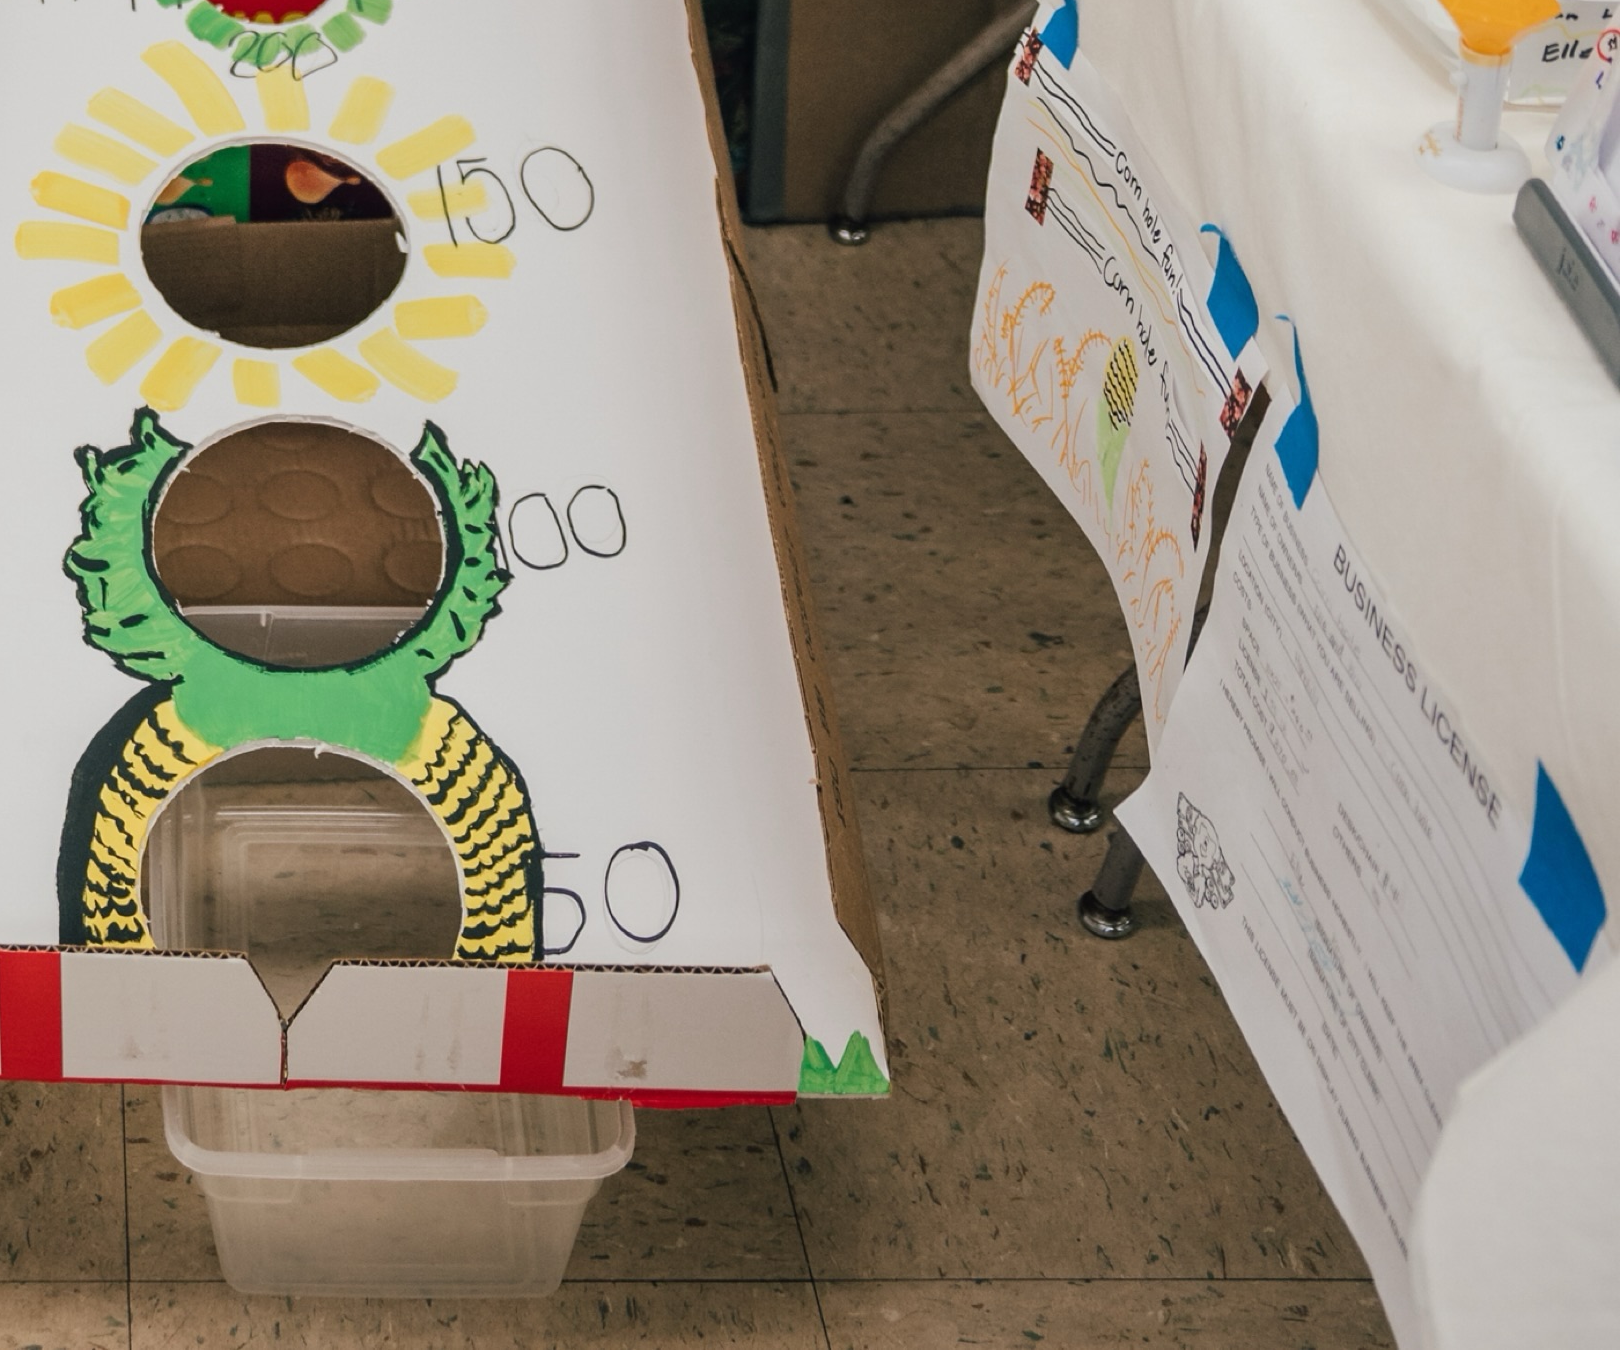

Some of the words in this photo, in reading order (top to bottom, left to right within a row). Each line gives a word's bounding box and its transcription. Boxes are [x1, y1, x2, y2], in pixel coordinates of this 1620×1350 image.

[436, 145, 595, 247] 150
[1115, 150, 1142, 201] Corn
[1140, 197, 1162, 245] hole
[1161, 243, 1185, 296] fun!
[1102, 255, 1135, 315] Corn
[1135, 303, 1158, 367] hole
[1248, 504, 1265, 536] TYPE
[1266, 550, 1296, 605] BUSINESS
[1264, 463, 1281, 498] NAME
[1282, 514, 1309, 566] BUSINESS
[1236, 550, 1265, 604] LOCATION
[1332, 543, 1419, 694] BUSINESS
[1418, 695, 1502, 832] LICENSE
[540, 840, 681, 959] 50
